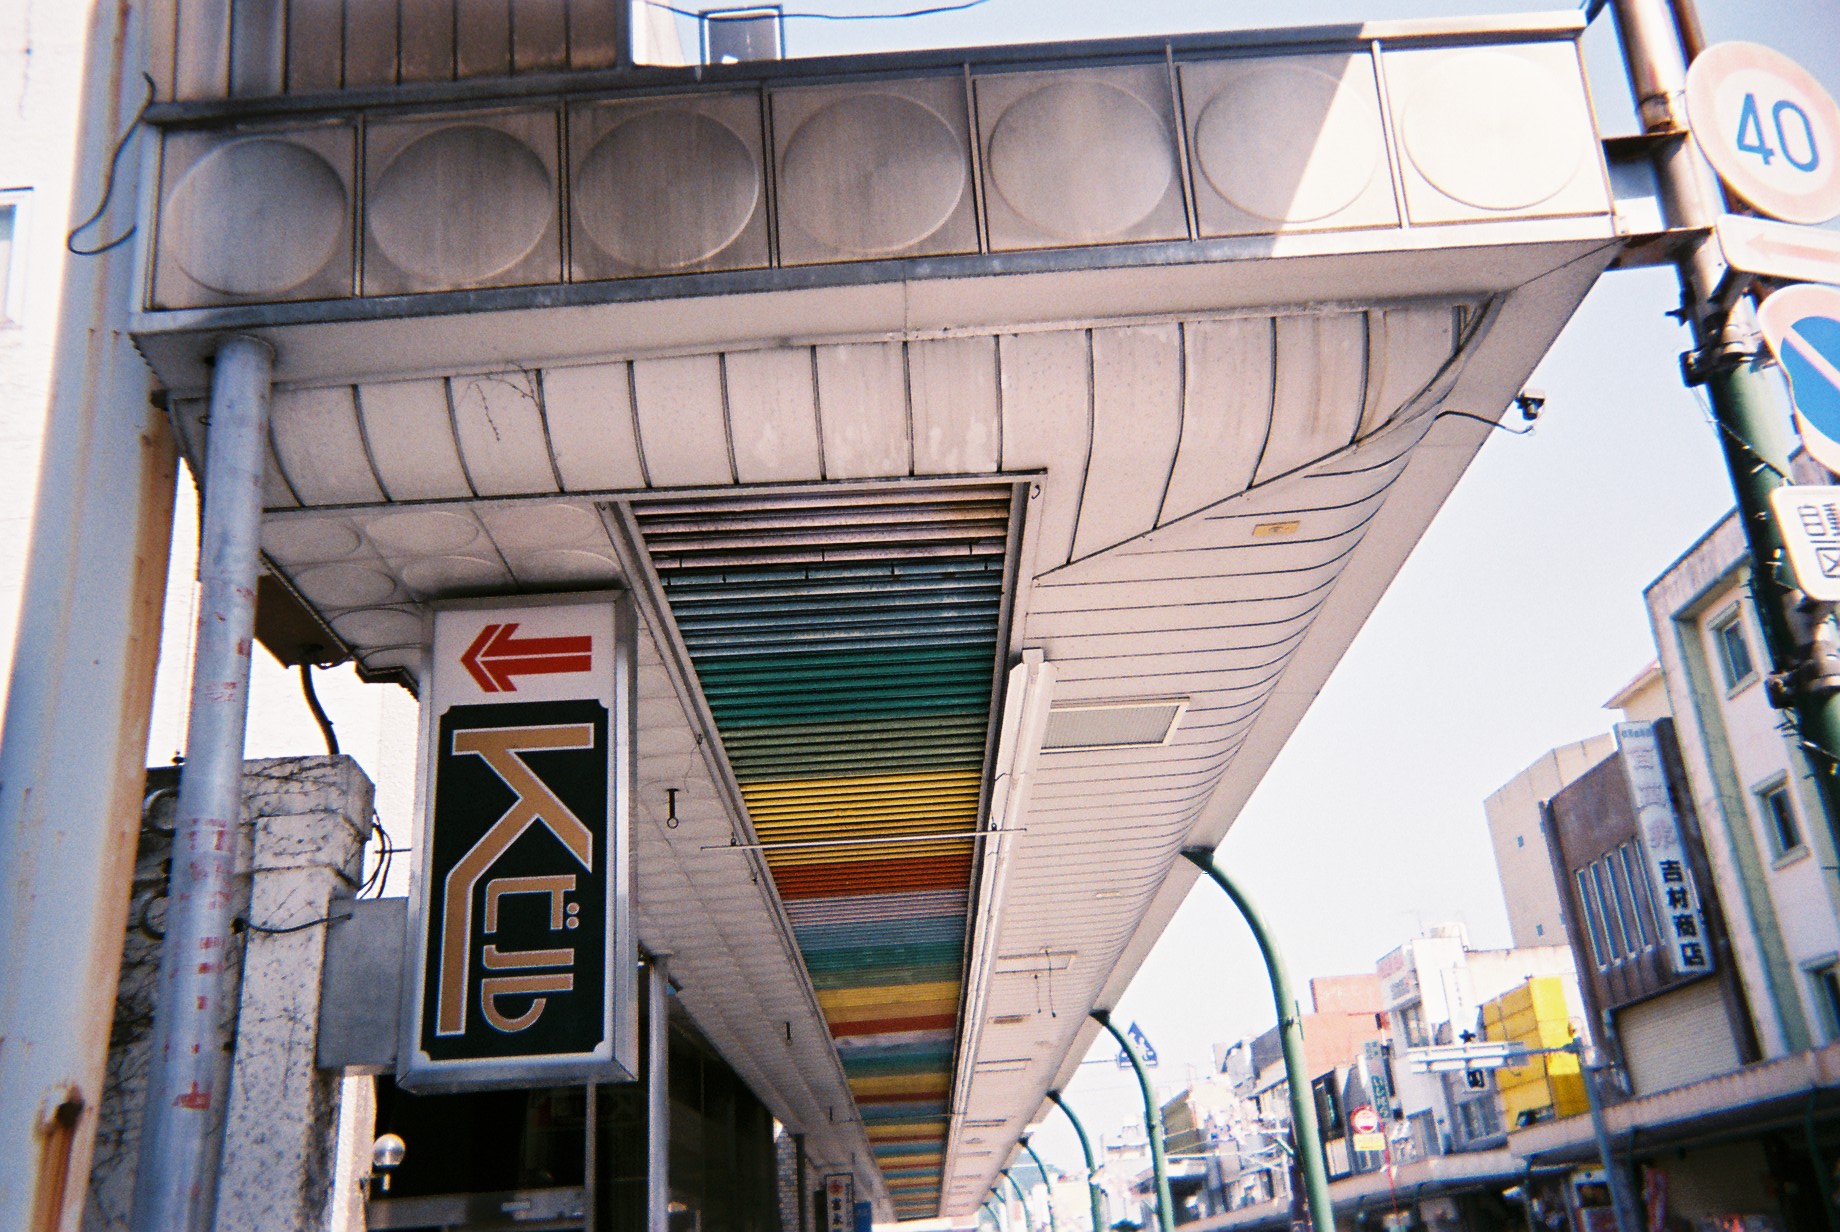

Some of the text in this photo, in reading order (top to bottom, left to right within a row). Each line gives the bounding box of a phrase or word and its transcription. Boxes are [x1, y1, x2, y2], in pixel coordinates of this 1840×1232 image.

[1737, 92, 1819, 173] 40
[1658, 857, 1708, 967] 吉村商店
